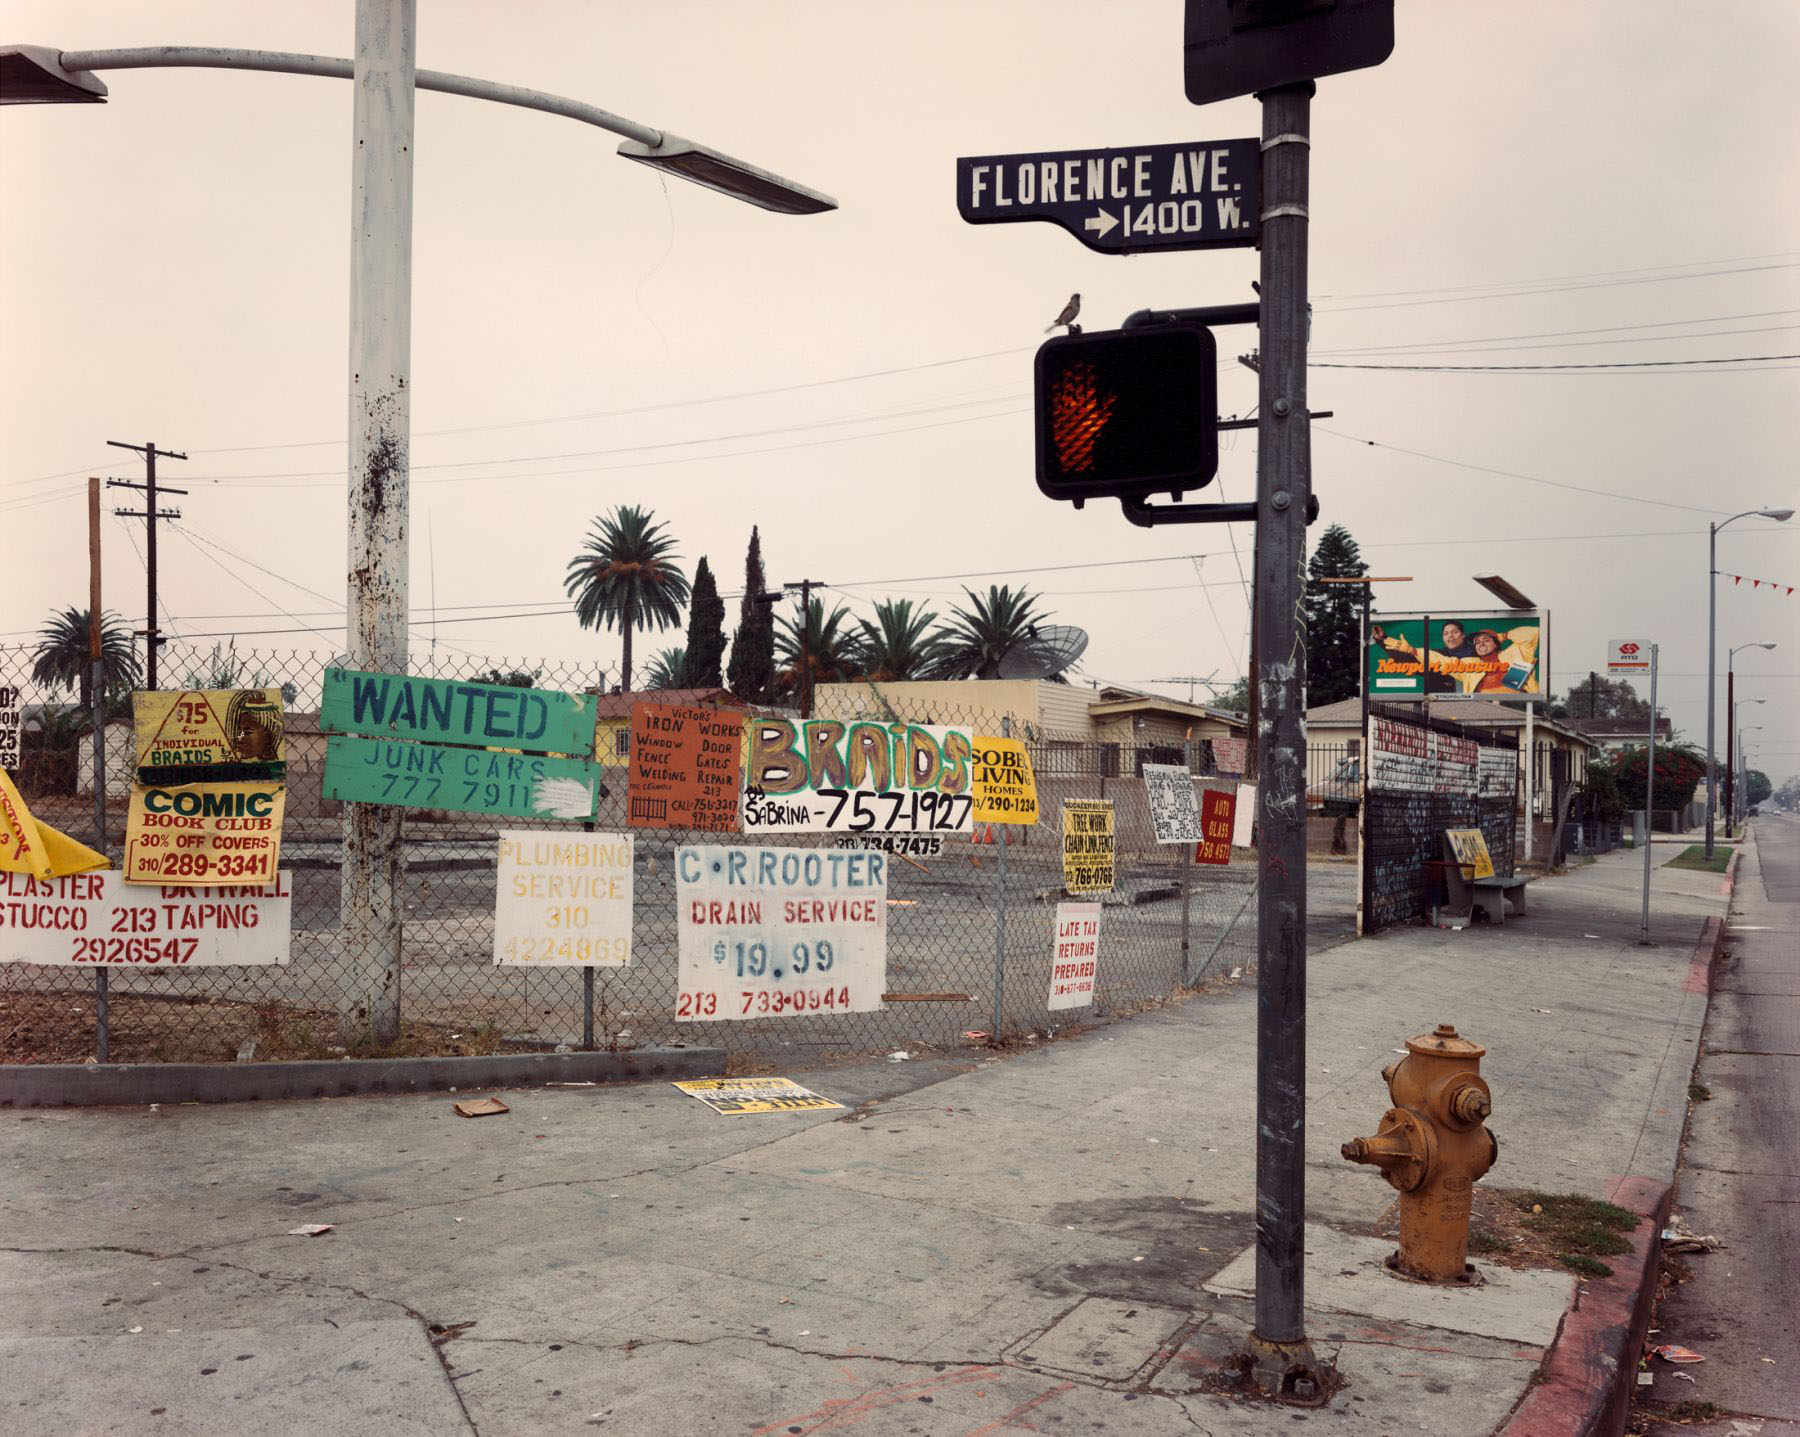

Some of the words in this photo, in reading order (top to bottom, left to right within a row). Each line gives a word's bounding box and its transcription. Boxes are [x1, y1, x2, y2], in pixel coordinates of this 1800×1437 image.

[972, 155, 1152, 207] FLORENCE
[1170, 149, 1241, 195] AVE.
[1123, 200, 1202, 237] 1400
[1217, 197, 1249, 230] W.
[1442, 658, 1509, 675] pleasure
[176, 702, 208, 724] $75
[181, 726, 199, 735] for
[646, 716, 685, 733] IRON
[699, 722, 741, 737] WORKS
[154, 739, 224, 750] INDIVIDUAL
[702, 739, 732, 754] DOOR
[0, 753, 17, 766] ES
[151, 749, 212, 765] BRAIDS
[364, 742, 446, 775] JUNK
[464, 754, 545, 782] CARS
[637, 748, 672, 764] FENCE
[696, 754, 731, 769] GATES
[972, 767, 1031, 785] LIVING
[381, 773, 442, 800] 777
[462, 780, 530, 808] 7911
[703, 786, 721, 796] 213
[984, 785, 1023, 795] HOMES
[144, 789, 273, 818] COMIC
[972, 796, 1035, 812] 13/290-1234
[1213, 799, 1230, 817] AUTO
[142, 813, 206, 830] BOOK
[215, 818, 272, 831] CLUB
[1072, 813, 1088, 833] TREE
[1208, 820, 1229, 839] GLASS
[140, 834, 170, 848] 30%
[176, 835, 206, 848] OFF
[212, 836, 269, 849] COVERS
[138, 852, 268, 876] 310/289-3341
[498, 841, 632, 868] PLUMBING
[758, 851, 884, 888] ROOTER
[512, 874, 625, 899] SERVICE
[111, 907, 157, 932] 213
[162, 904, 259, 930] TAPING
[544, 905, 590, 929] 310
[692, 900, 762, 925] DRAIN
[784, 899, 876, 924] SERVICE
[1060, 921, 1080, 937] LATE
[1083, 921, 1097, 936] TAX
[72, 937, 199, 964] 2926547
[1059, 942, 1095, 958] RETURNS
[1055, 962, 1095, 980] PREPARED
[677, 991, 717, 1017] 213
